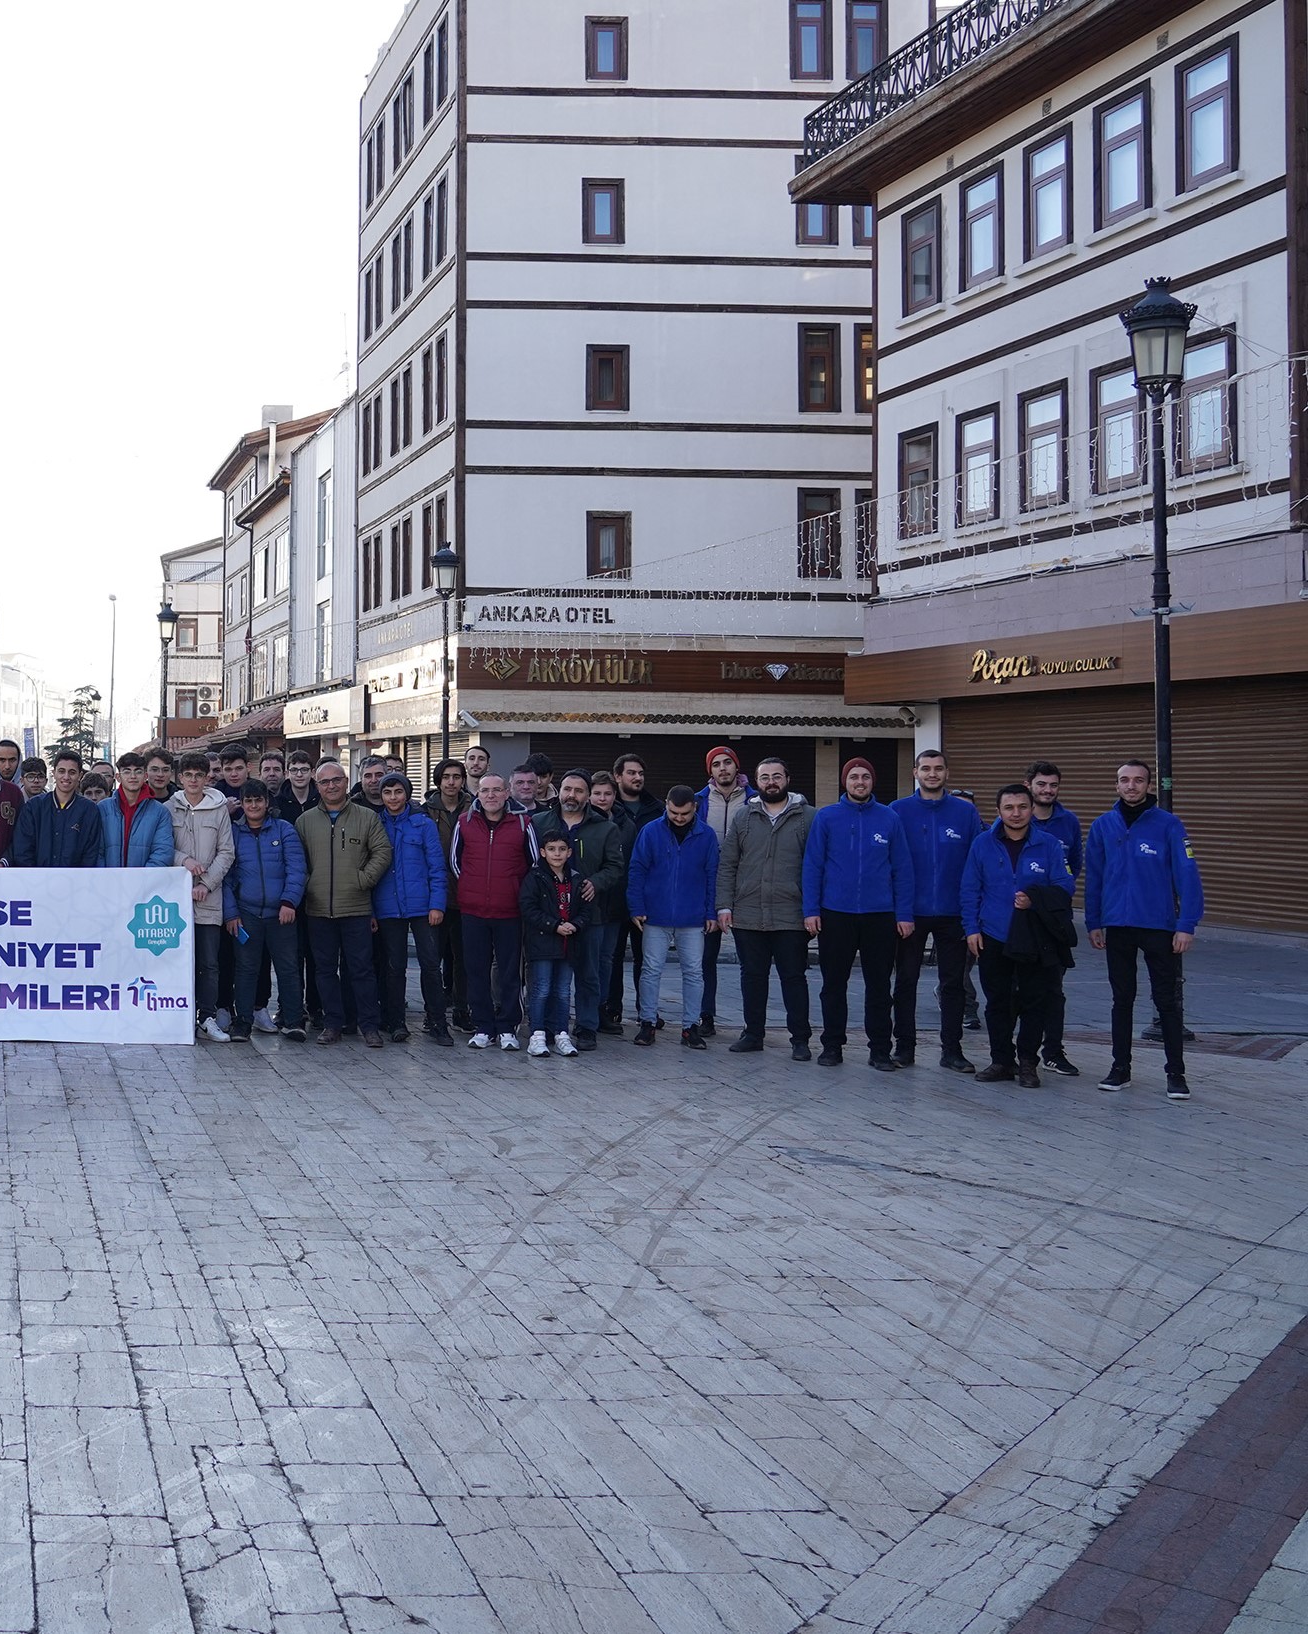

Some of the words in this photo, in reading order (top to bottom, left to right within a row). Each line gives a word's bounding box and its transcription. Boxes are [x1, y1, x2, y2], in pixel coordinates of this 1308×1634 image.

[478, 605, 561, 623] ANKARA
[565, 607, 616, 624] OTEL
[526, 653, 653, 685] AKKÖYLÜLER
[720, 661, 763, 680] blue
[137, 927, 177, 938] ATABEY
